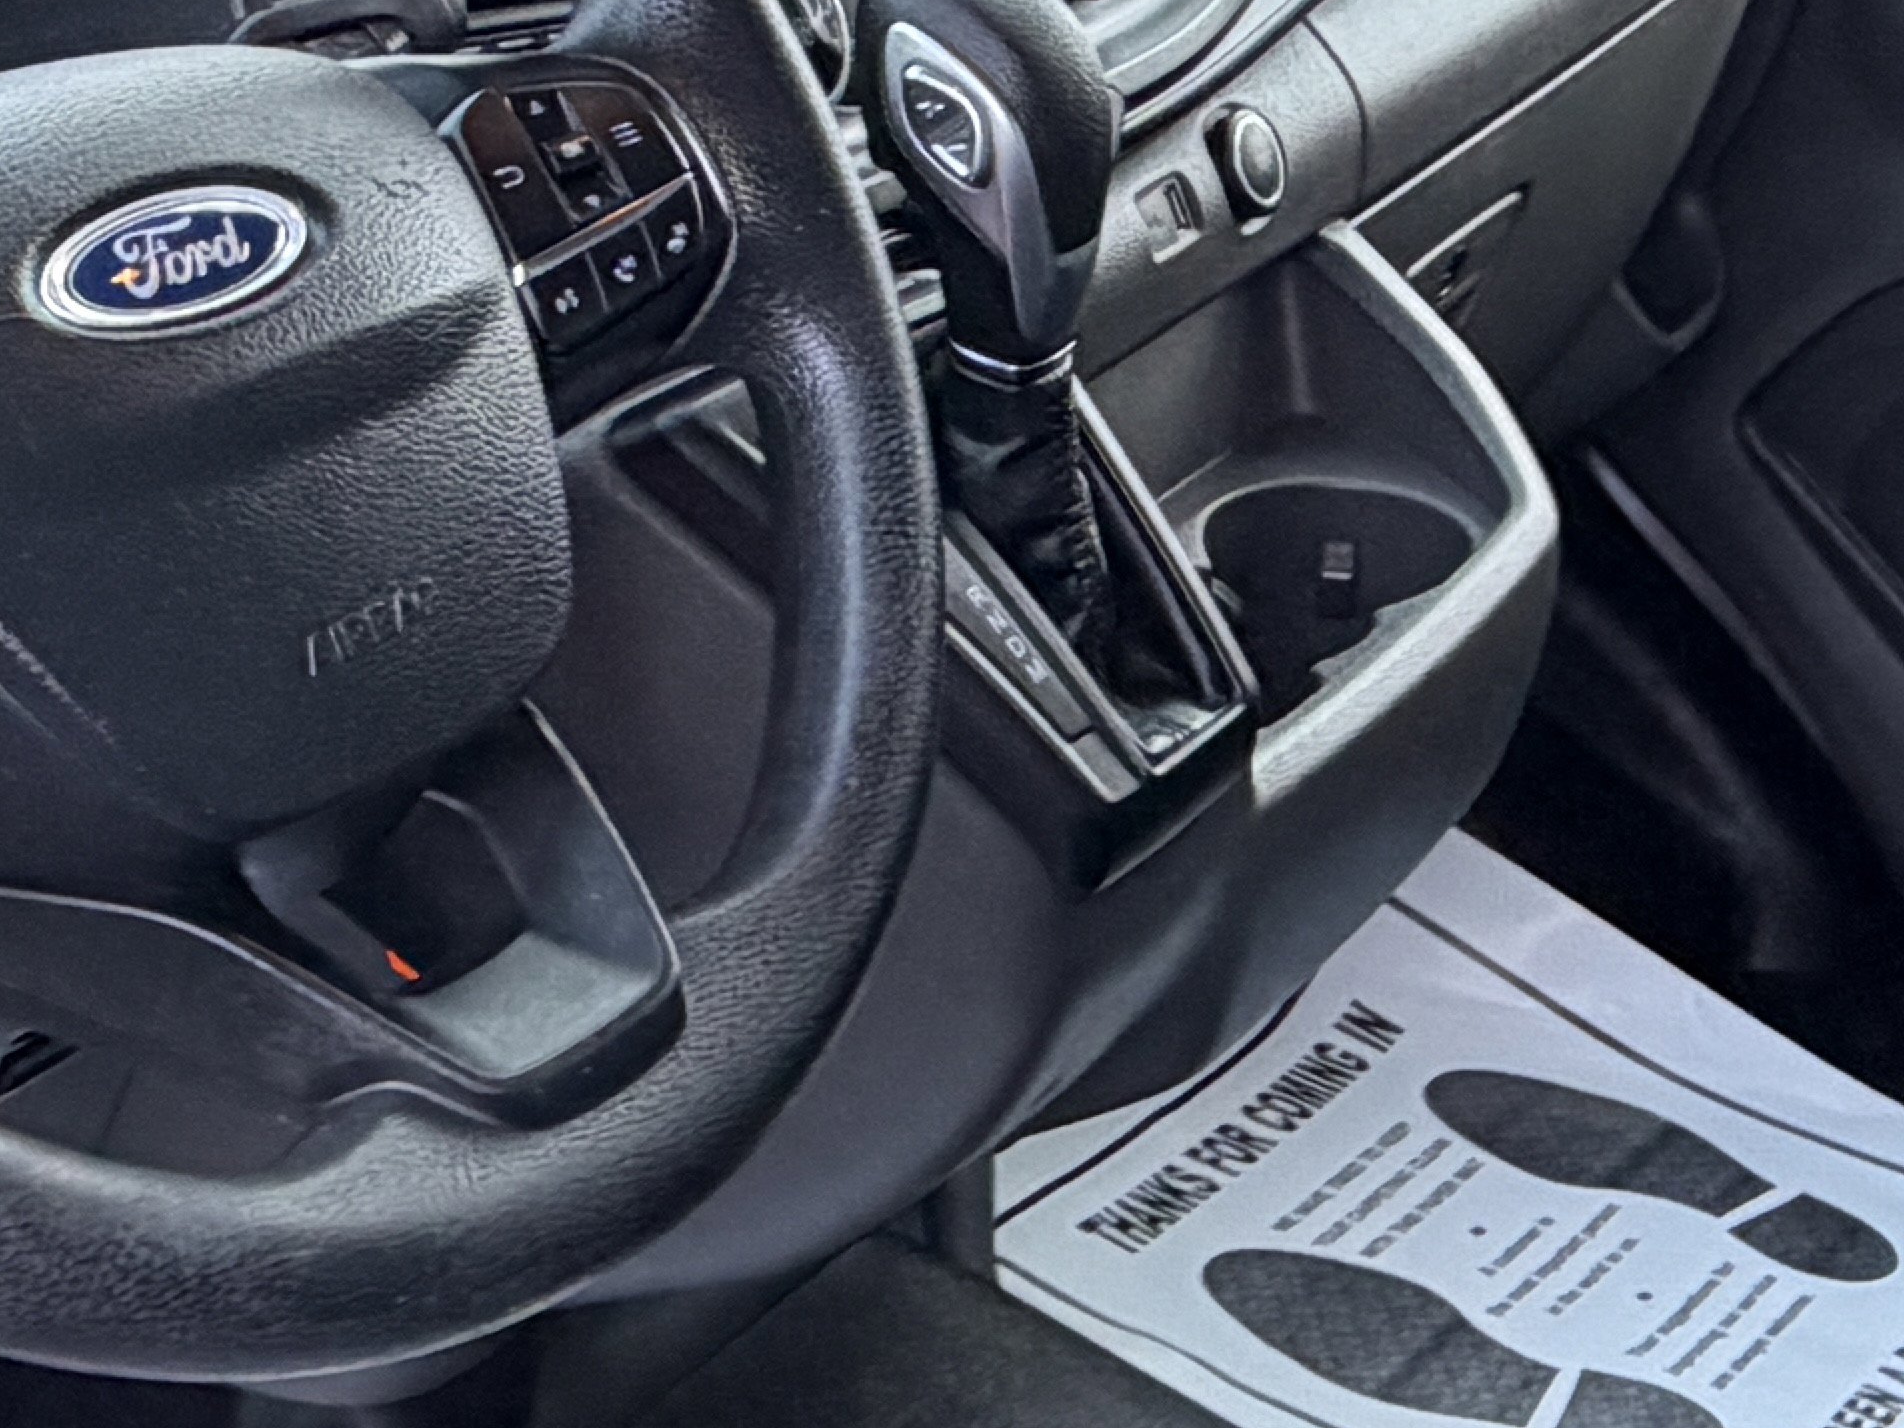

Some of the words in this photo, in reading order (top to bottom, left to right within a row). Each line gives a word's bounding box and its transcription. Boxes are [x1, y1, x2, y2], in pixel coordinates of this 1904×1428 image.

[110, 212, 251, 300] Ford
[1078, 1165, 1220, 1253] THANKS
[1181, 1123, 1279, 1176] FOR
[1240, 1041, 1372, 1133] COMING
[1333, 998, 1406, 1054] IN
